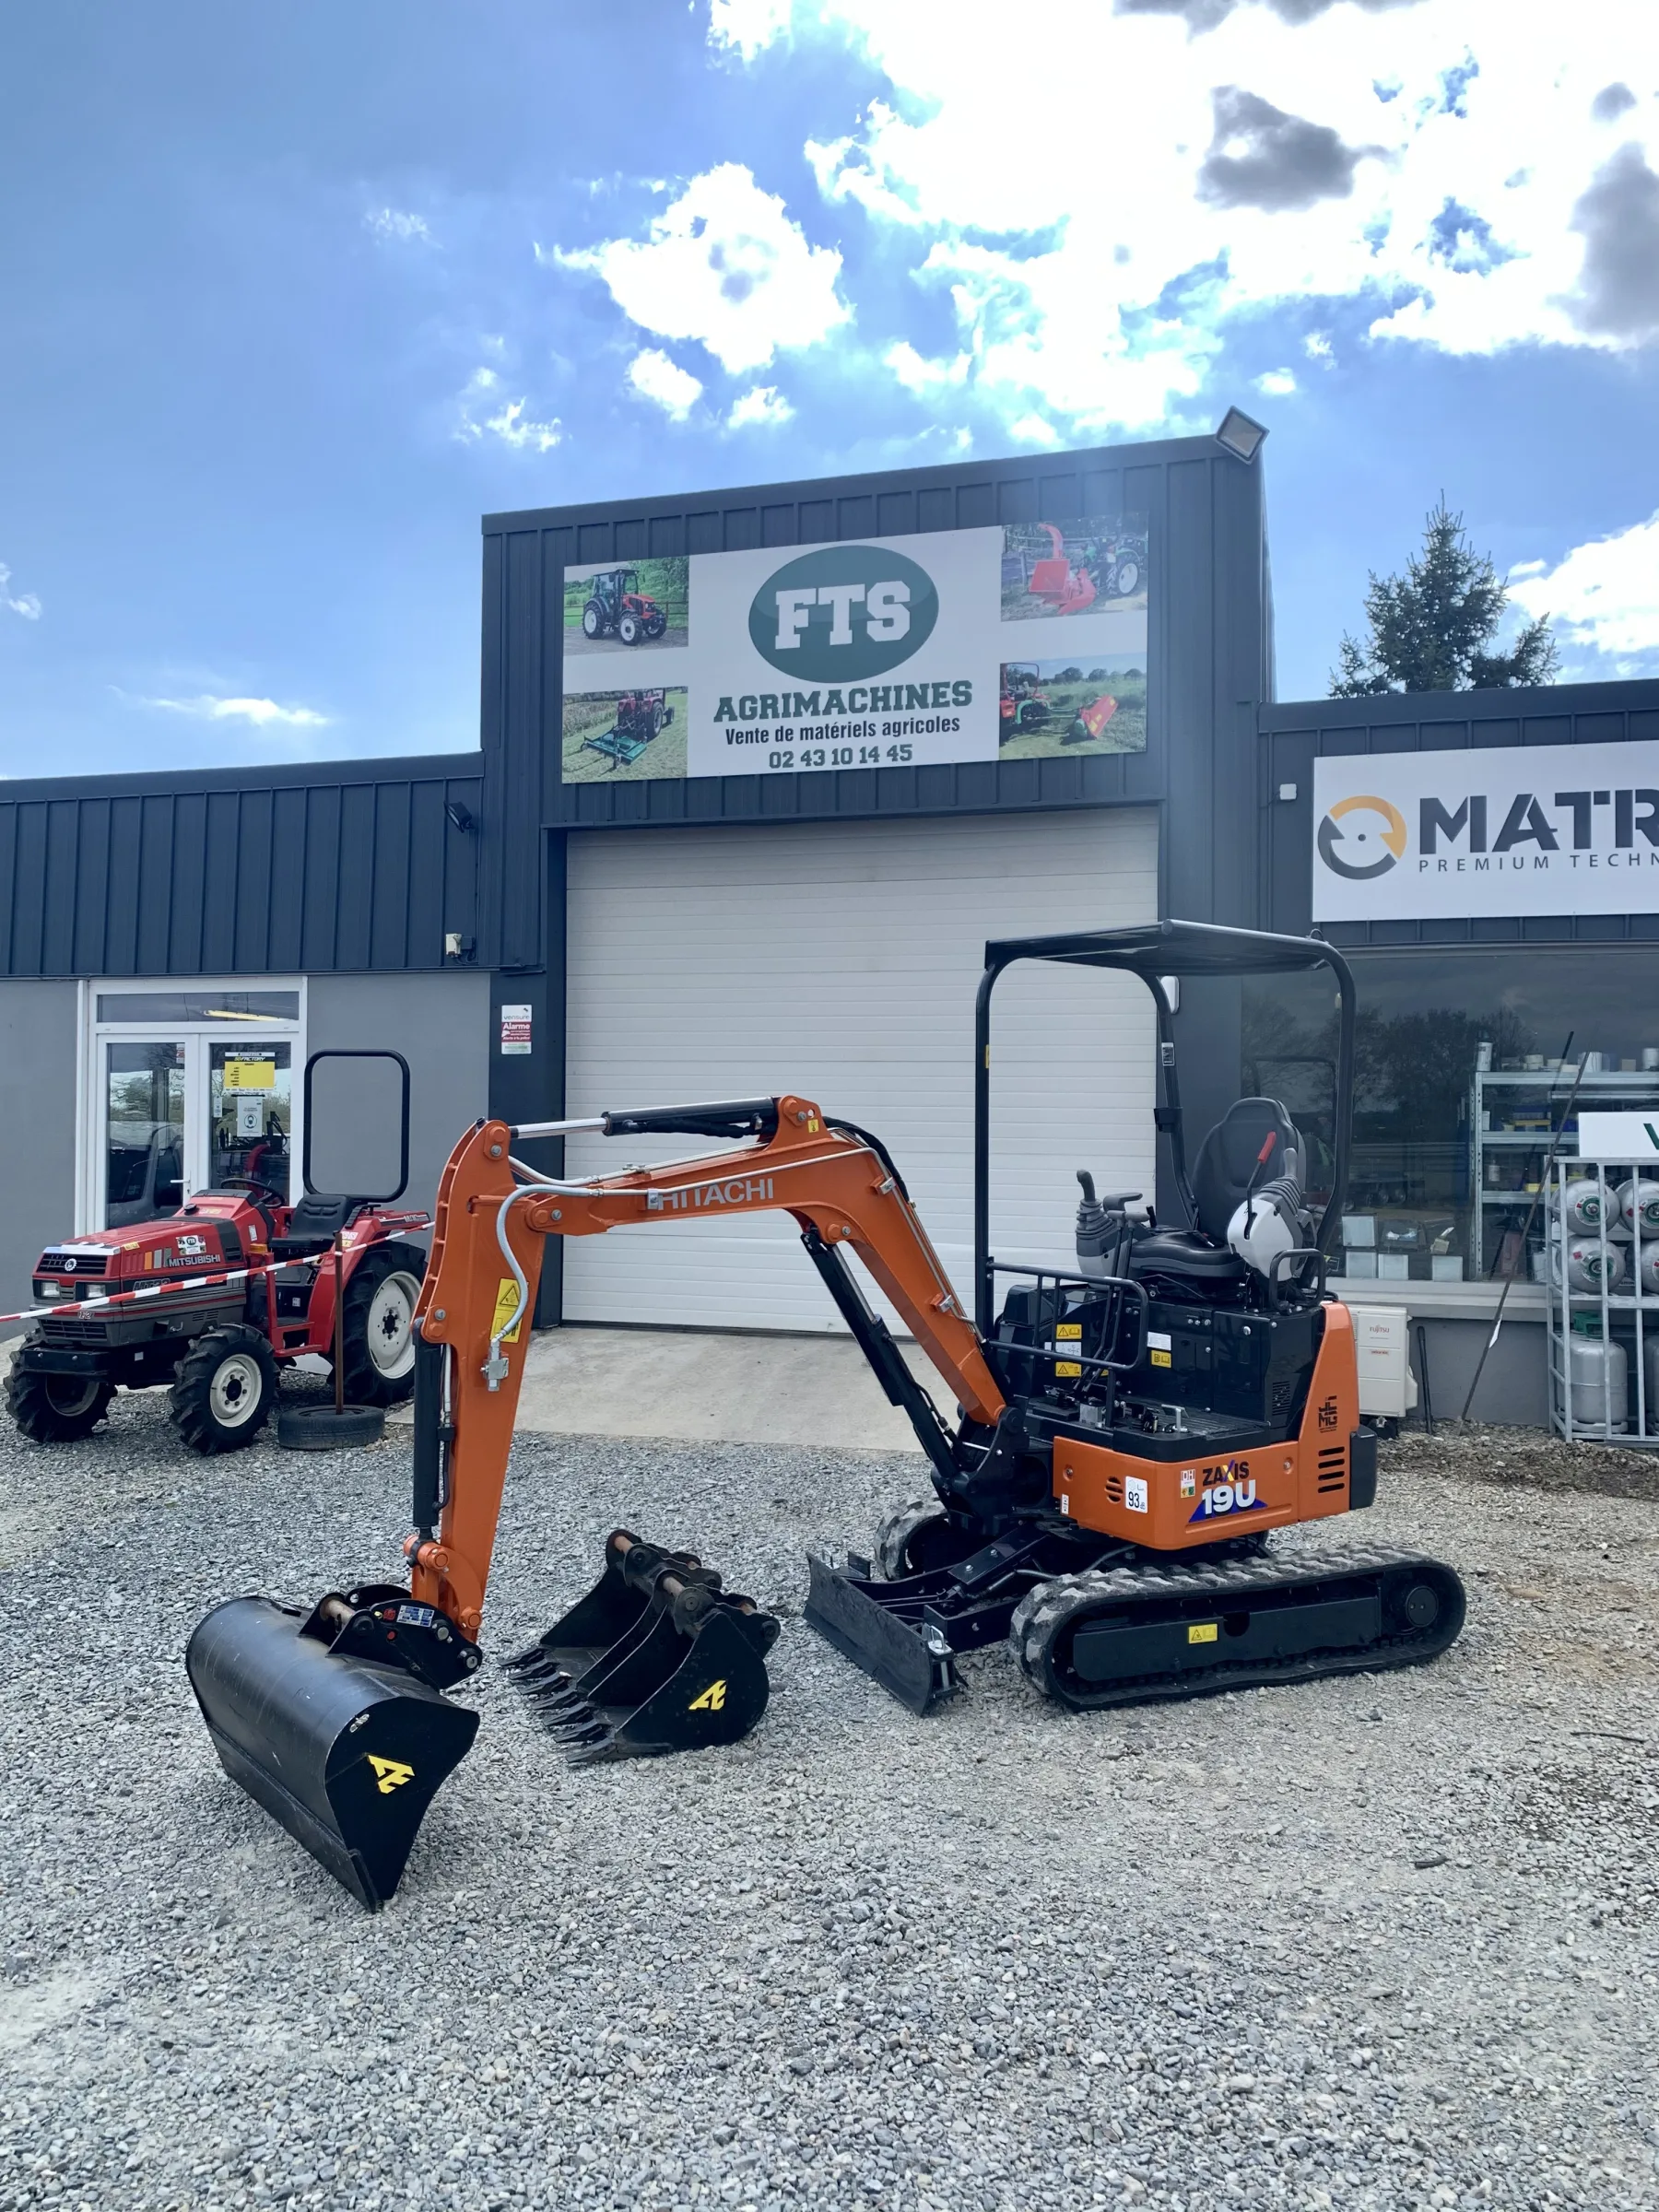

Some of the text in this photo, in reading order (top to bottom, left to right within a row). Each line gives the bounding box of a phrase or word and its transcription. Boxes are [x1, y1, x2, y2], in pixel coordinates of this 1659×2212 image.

[775, 580, 911, 650] FTS
[713, 680, 973, 723] AGRIMACHINES
[725, 715, 960, 745] Vente de matériels agricoles
[769, 744, 912, 769] 02 43 10 14 45
[1419, 789, 1659, 855] MATR
[1419, 855, 1549, 873] PREMIUM
[657, 1178, 774, 1211] HITACHI
[169, 1254, 220, 1267] MITSUBISHI
[1369, 1324, 1390, 1334] FUJITSU
[1202, 1459, 1250, 1486] ZAXIS
[1128, 1491, 1140, 1509] 93
[1202, 1479, 1256, 1515] 19U
